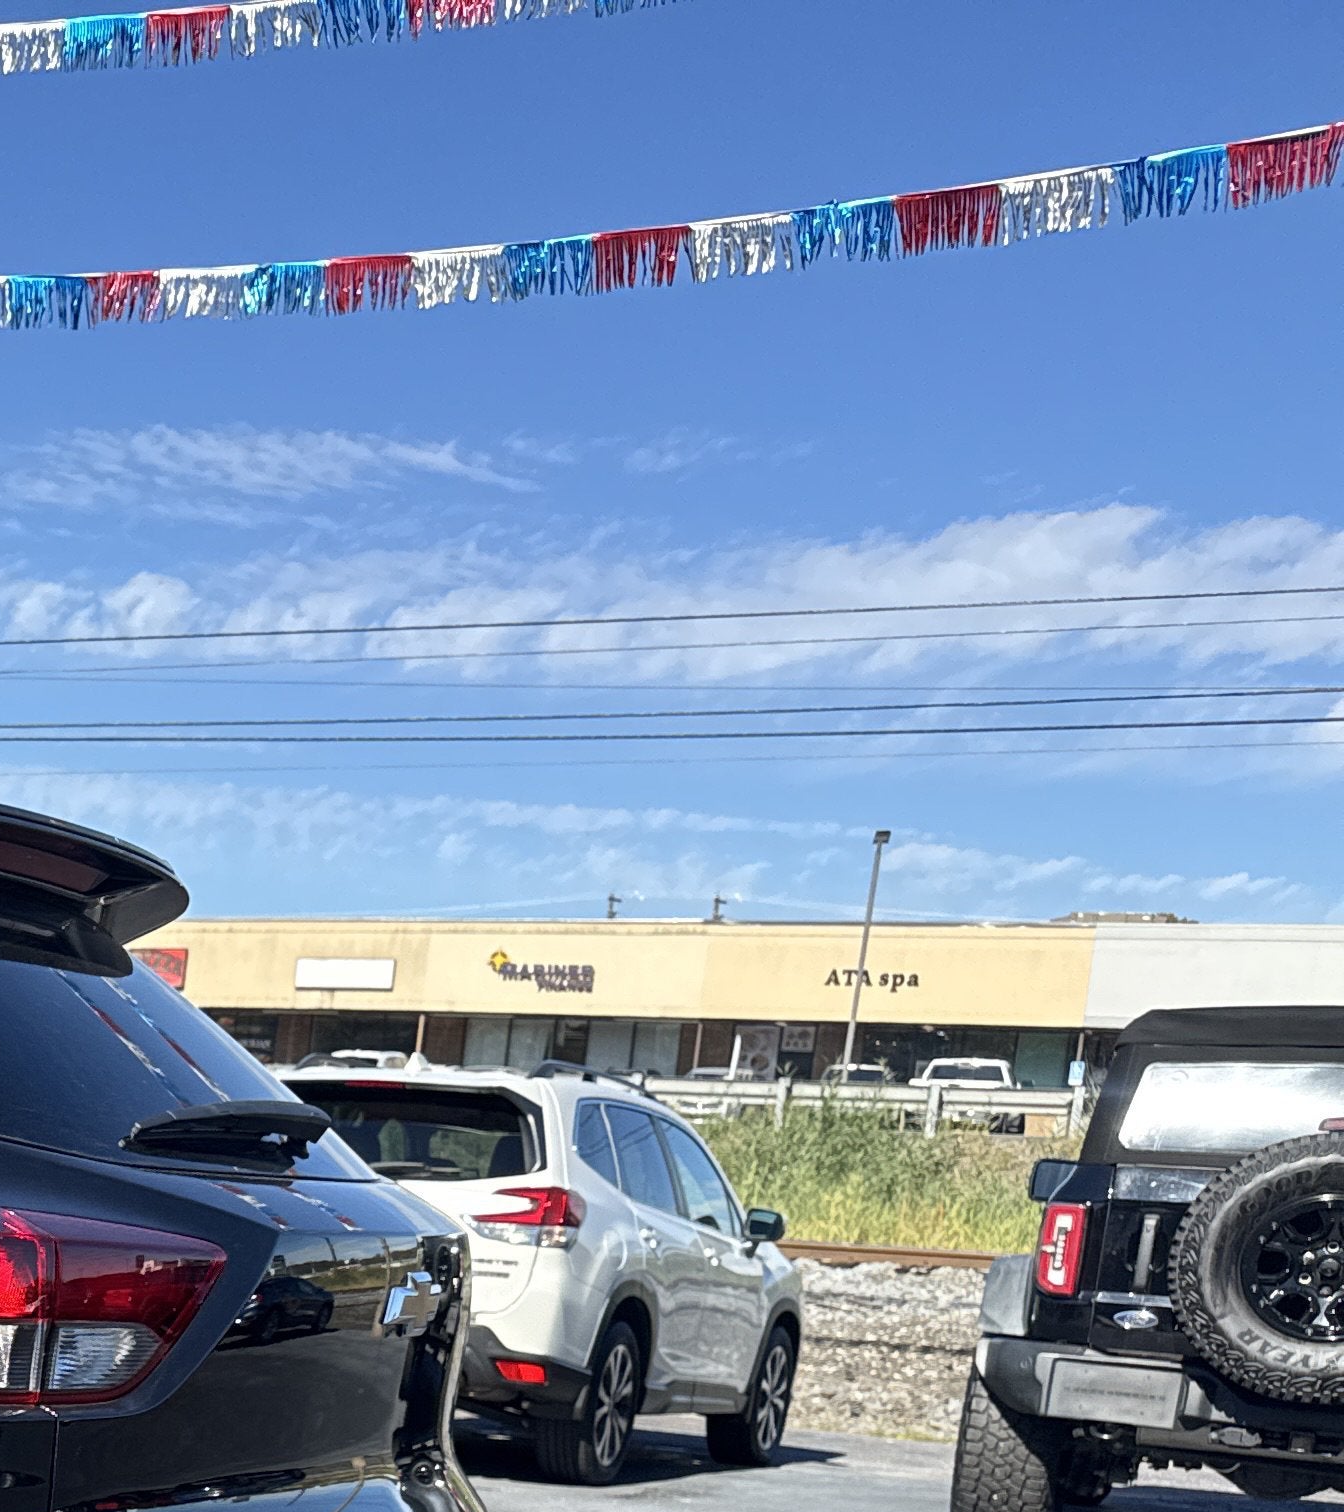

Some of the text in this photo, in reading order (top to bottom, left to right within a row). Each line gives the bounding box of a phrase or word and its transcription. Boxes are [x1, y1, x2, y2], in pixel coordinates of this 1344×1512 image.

[499, 962, 595, 981] MARINER
[824, 968, 920, 993] ATA spa
